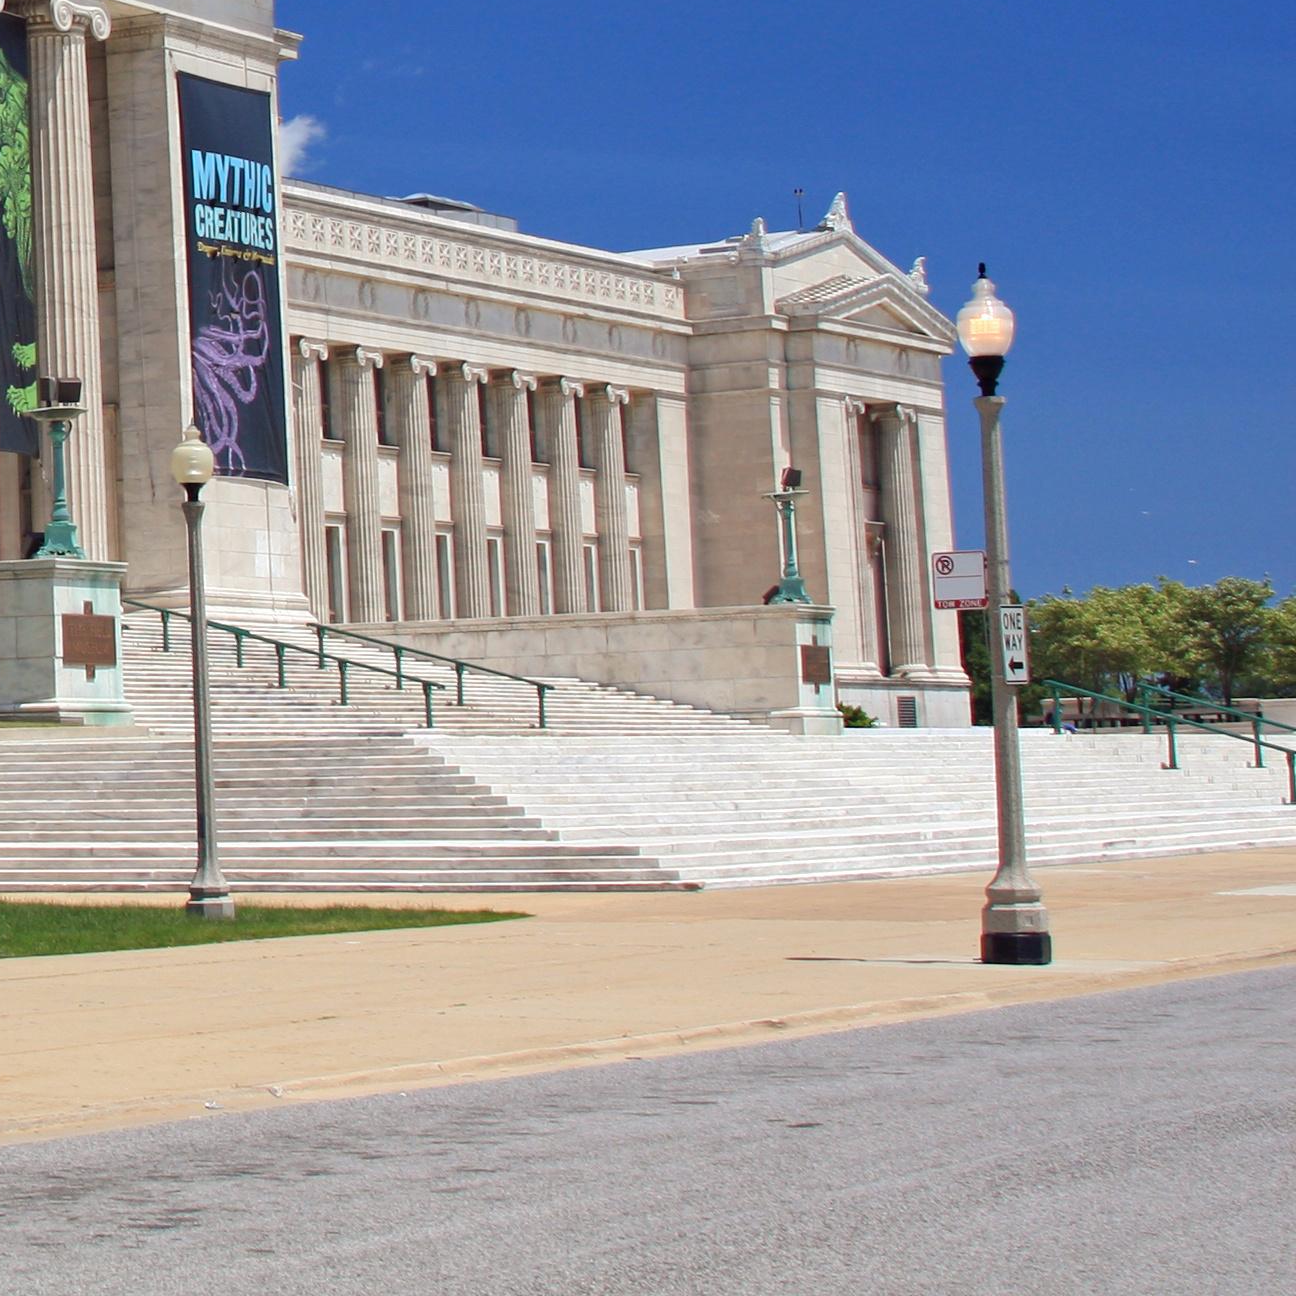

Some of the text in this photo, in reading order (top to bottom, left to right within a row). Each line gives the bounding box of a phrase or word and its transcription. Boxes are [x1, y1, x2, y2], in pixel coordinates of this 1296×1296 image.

[191, 149, 273, 213] MYTHIC
[194, 203, 274, 251] CREATURES
[937, 599, 983, 608] TOW ZONE
[1002, 612, 1022, 630] ONE
[1004, 634, 1023, 651] WAY
